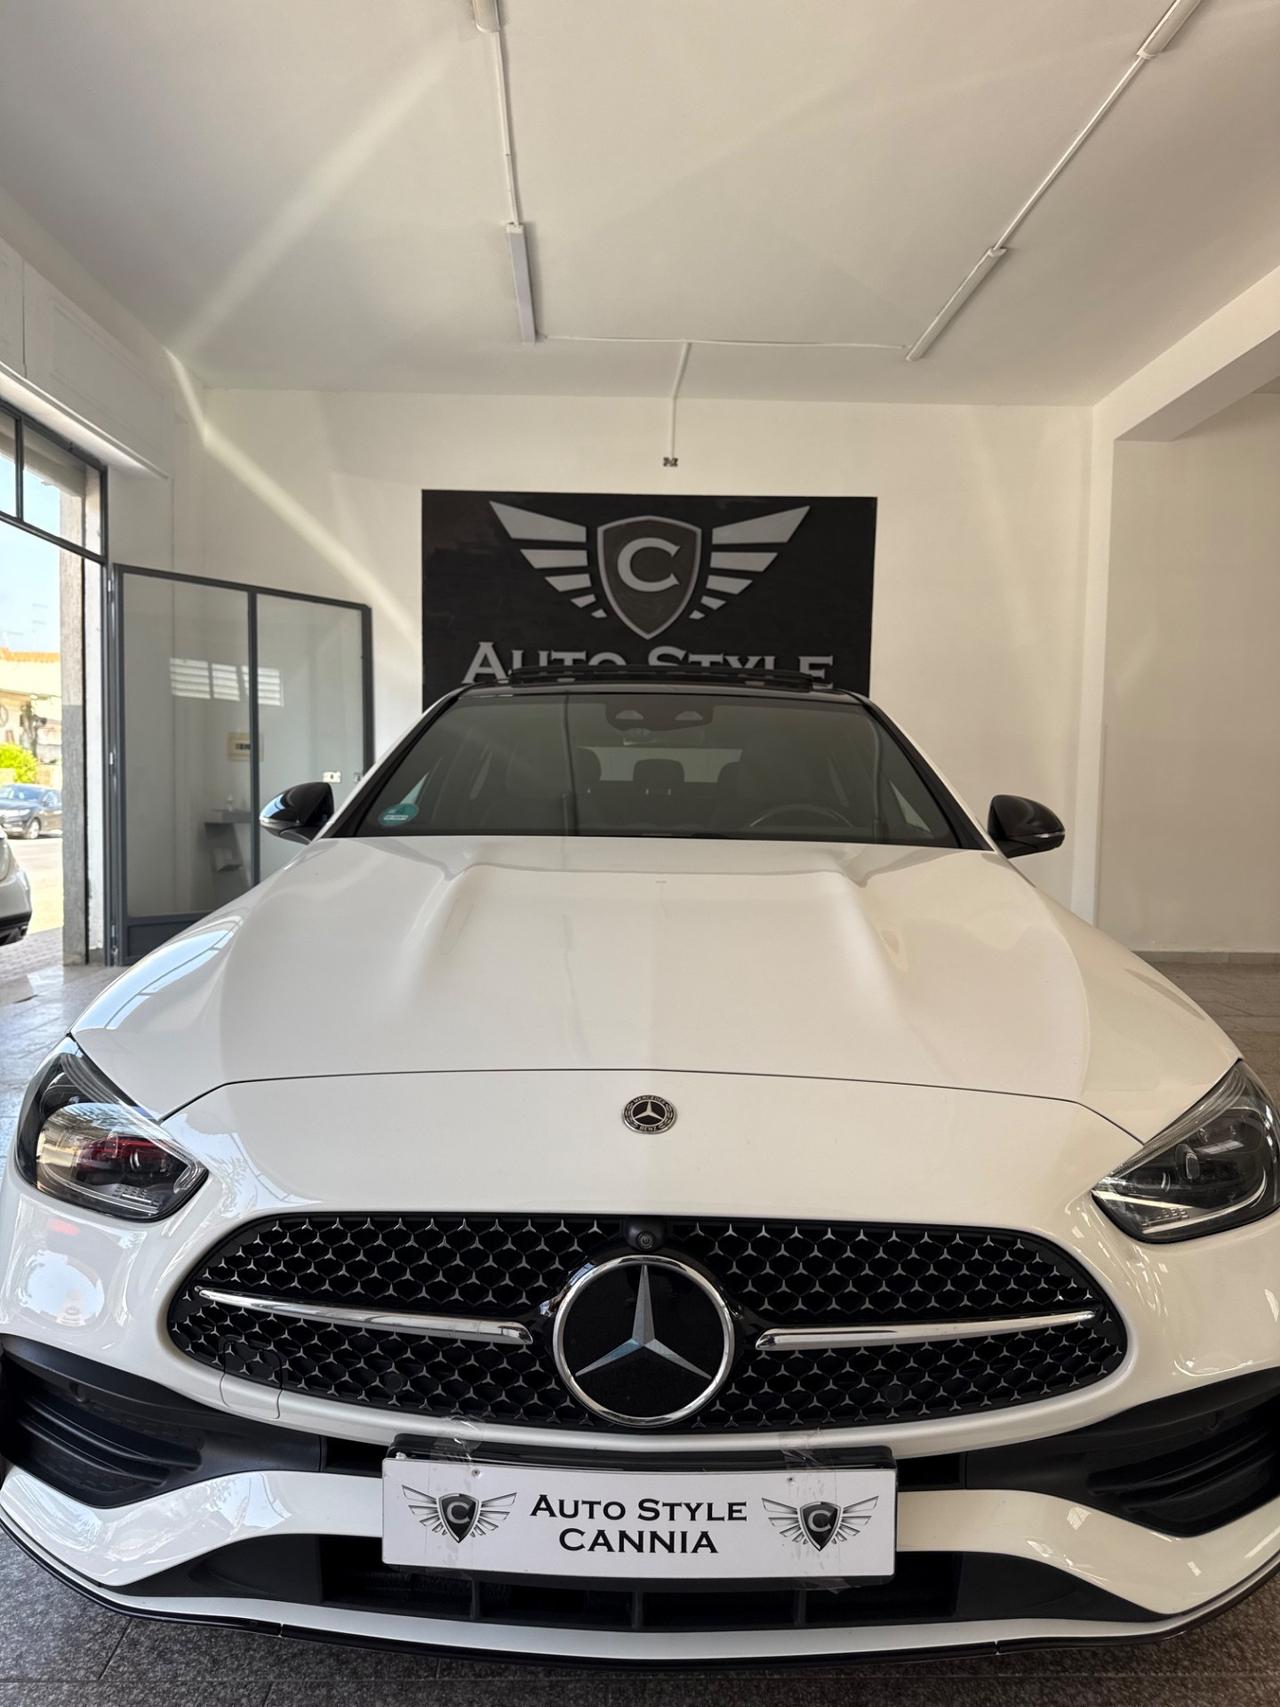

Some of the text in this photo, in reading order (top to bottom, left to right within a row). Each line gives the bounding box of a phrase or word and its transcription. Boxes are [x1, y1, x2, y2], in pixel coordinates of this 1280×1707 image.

[617, 537, 681, 592] C
[446, 1501, 471, 1524] C
[529, 1494, 748, 1522] AUTO STYLE
[807, 1509, 833, 1532] C
[558, 1527, 719, 1554] CANNIA
